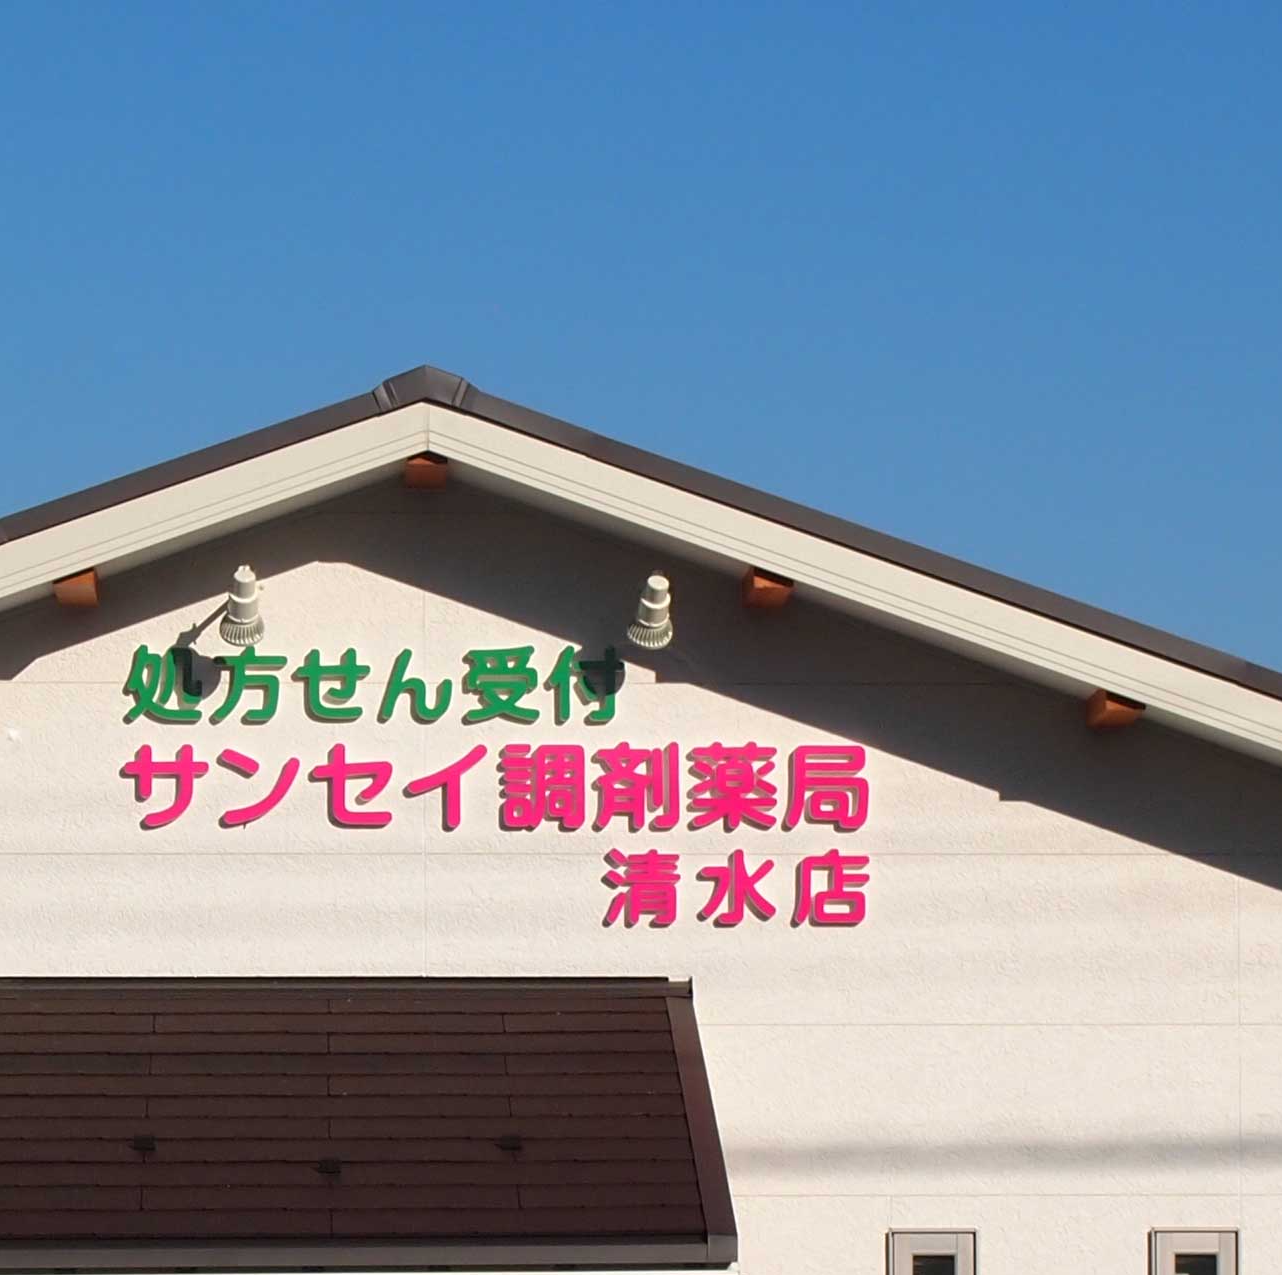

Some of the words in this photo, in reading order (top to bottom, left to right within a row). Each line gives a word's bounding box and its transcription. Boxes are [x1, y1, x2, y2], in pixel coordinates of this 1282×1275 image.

[122, 645, 625, 722] 処方せん受付
[122, 742, 870, 831] サンセイ調剤薬局
[603, 848, 870, 928] 清水店
